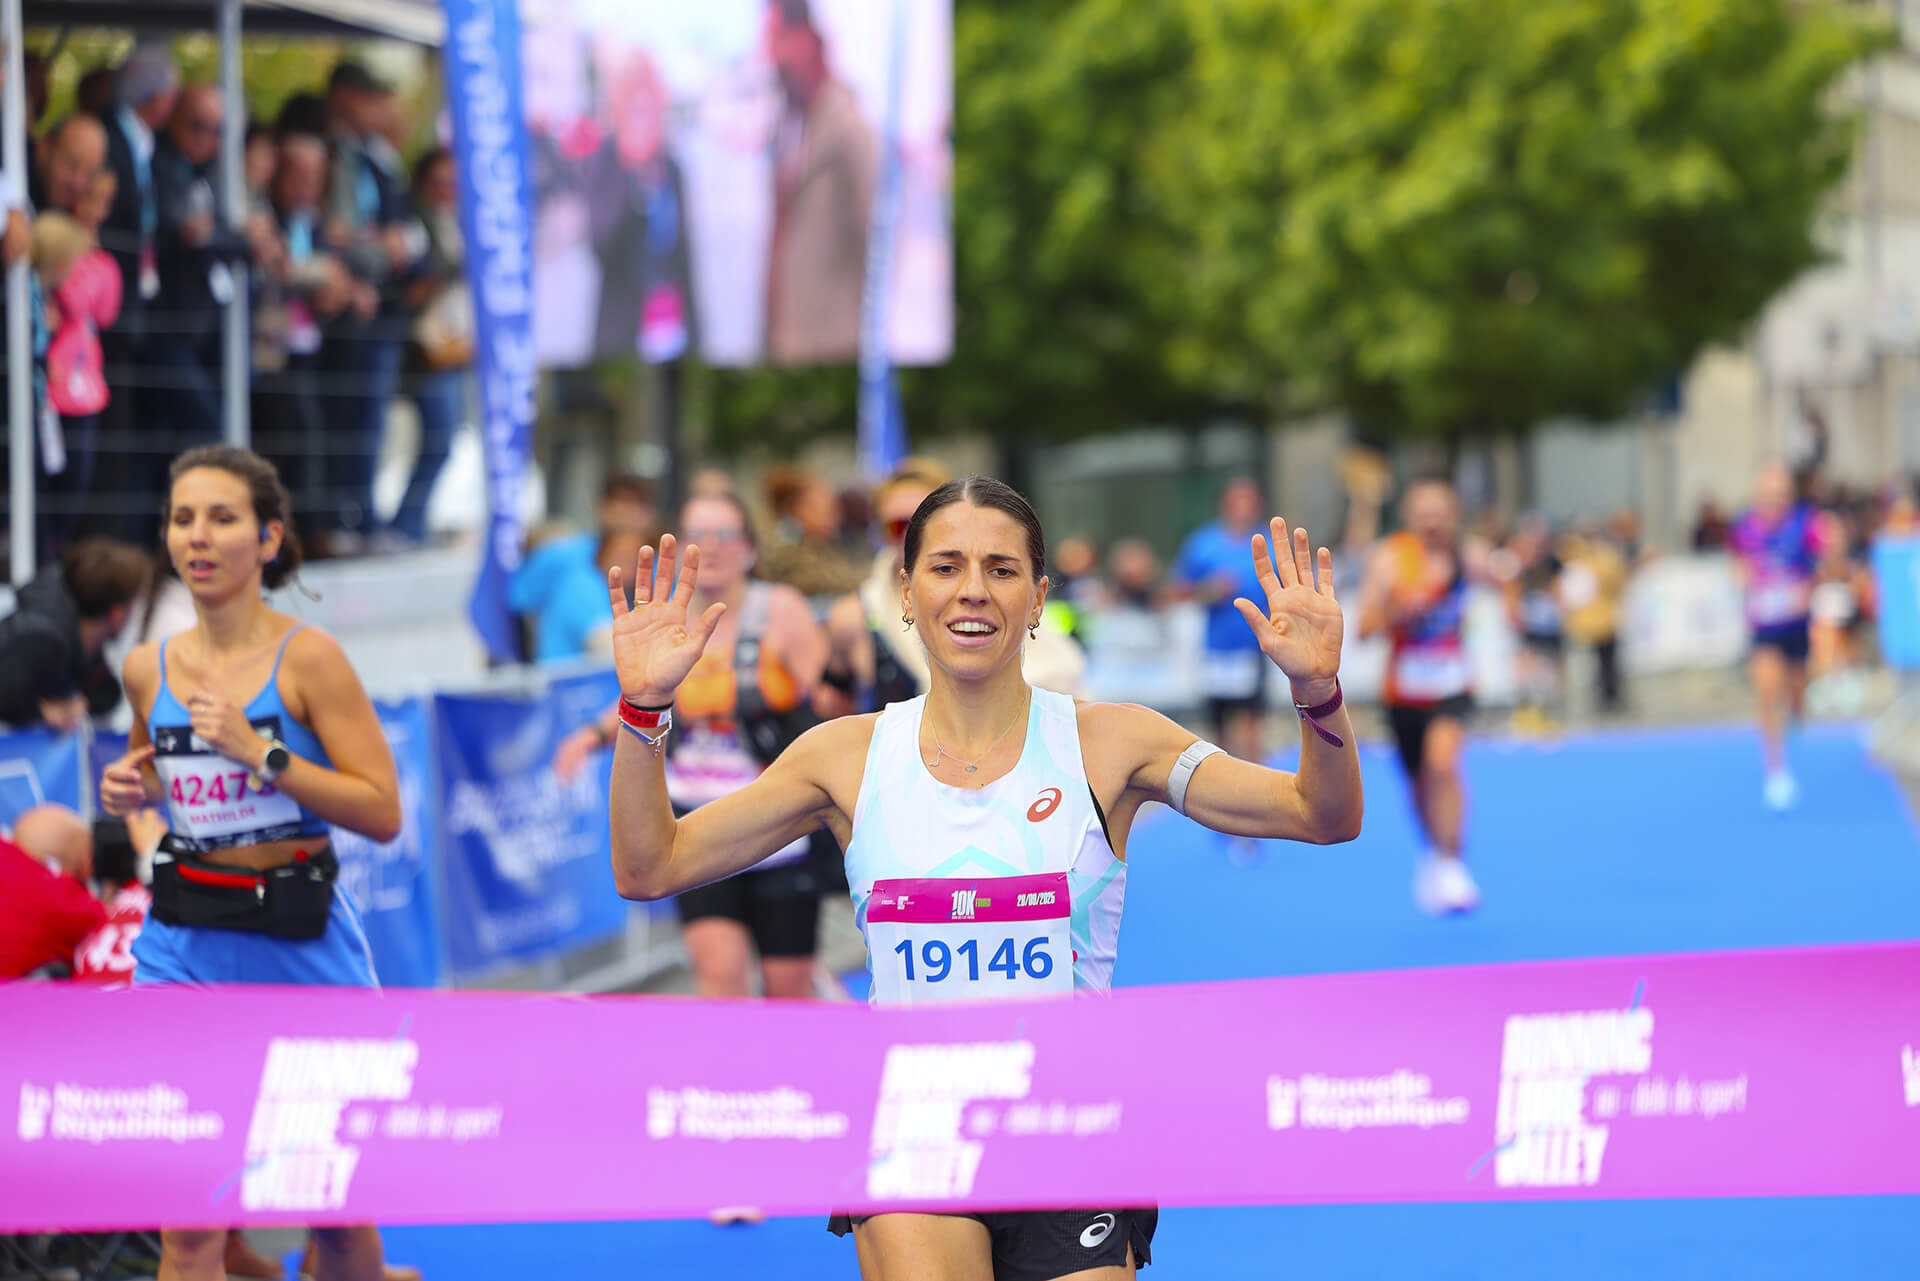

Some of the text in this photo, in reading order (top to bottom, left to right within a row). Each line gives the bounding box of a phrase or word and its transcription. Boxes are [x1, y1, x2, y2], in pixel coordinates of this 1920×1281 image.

[951, 890, 976, 916] 10K
[894, 937, 1053, 982] 19146
[1300, 1070, 1432, 1100] Nouvelle
